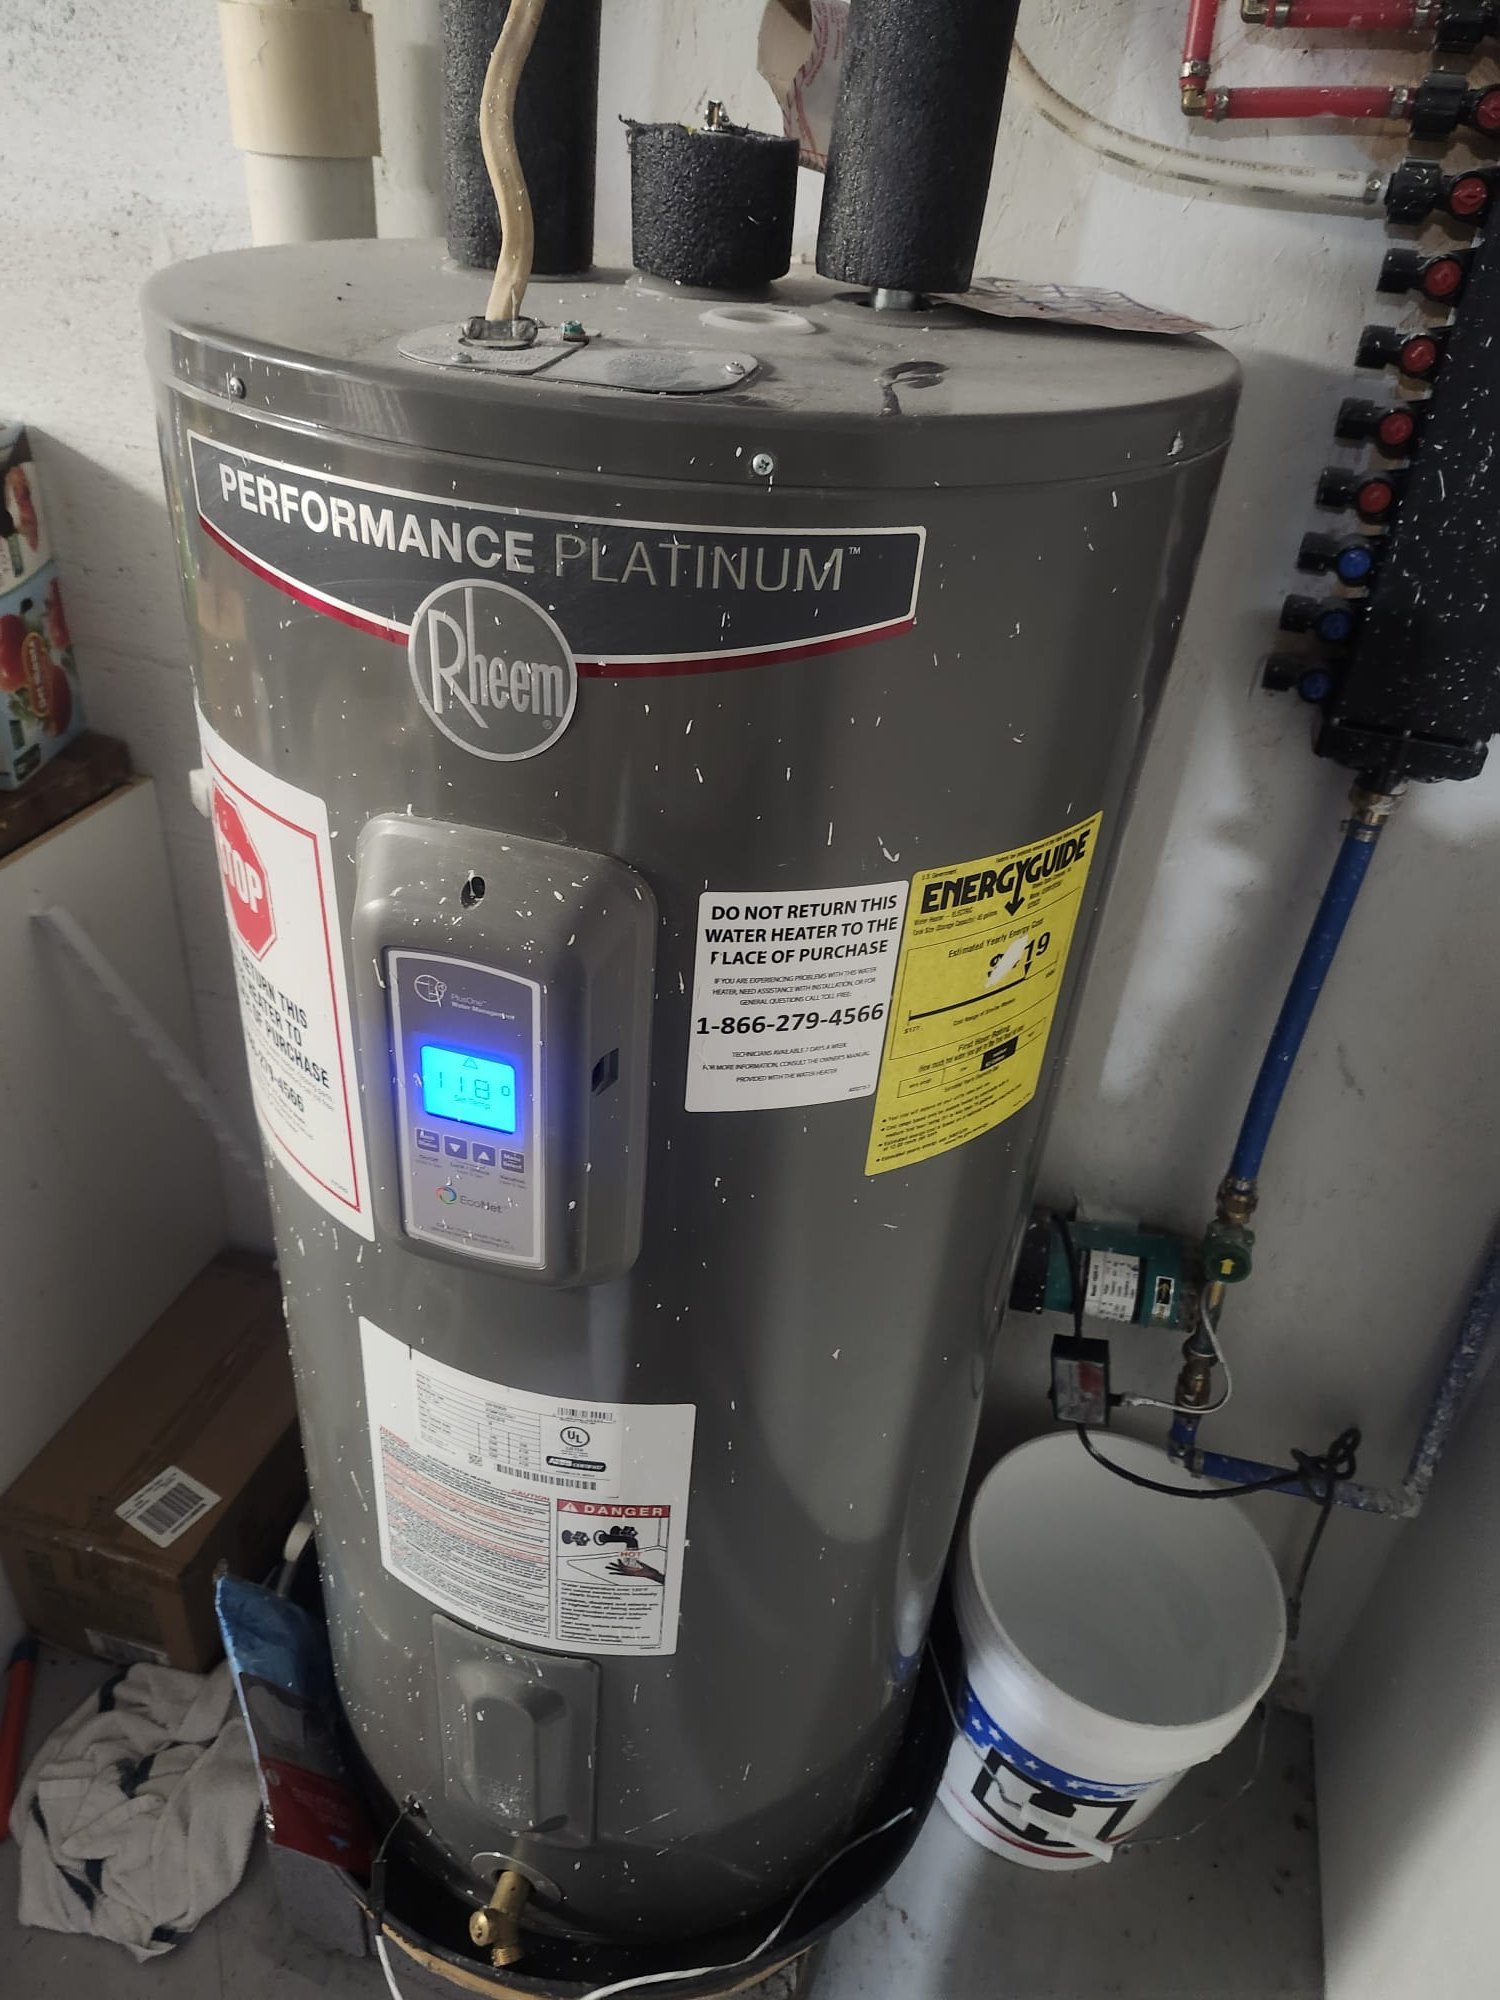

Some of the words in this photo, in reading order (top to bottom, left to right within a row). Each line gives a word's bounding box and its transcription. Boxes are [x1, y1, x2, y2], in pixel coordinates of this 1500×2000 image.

[220, 462, 535, 576] PERFORMANCE
[426, 587, 564, 729] Rheem
[921, 829, 1090, 915] ENERGYGUIDE
[711, 906, 740, 921] DO
[744, 905, 784, 920] NOT
[787, 900, 857, 919] RETURN
[860, 895, 898, 912] THIS
[705, 928, 766, 943] WATER
[770, 923, 838, 942] HEATER
[841, 921, 864, 936] TO
[867, 916, 899, 932] THE
[948, 940, 984, 958] Estimated
[986, 933, 1007, 947] Yearly
[1008, 925, 1030, 939] Energy
[771, 949, 796, 964] OF
[799, 939, 889, 962] PURCHASE
[278, 991, 308, 1029] THIS
[696, 1003, 884, 1035] 1-866-279-4566
[460, 1195, 503, 1213] EcoNet
[583, 1504, 663, 1517] DANGER
